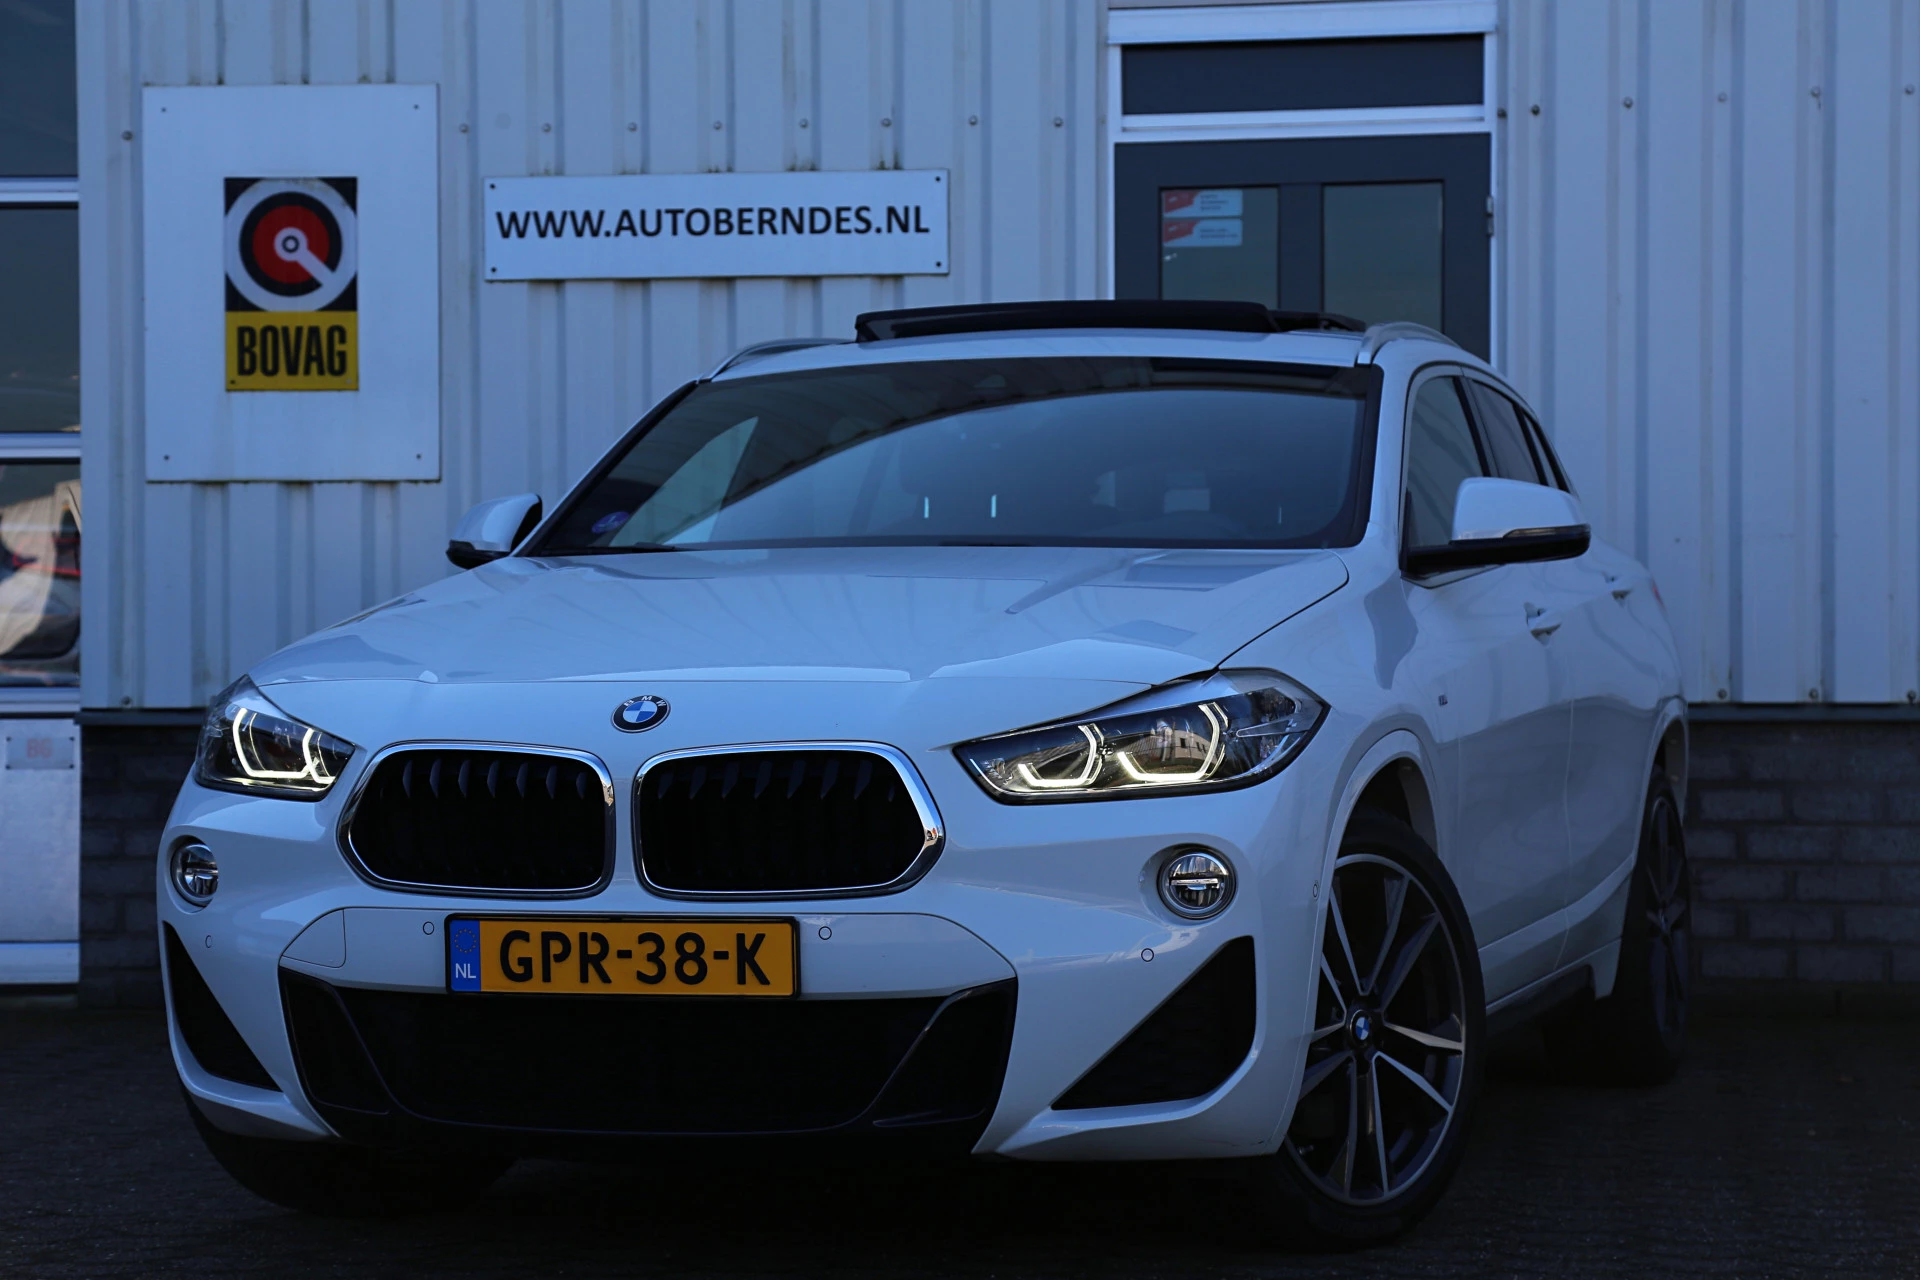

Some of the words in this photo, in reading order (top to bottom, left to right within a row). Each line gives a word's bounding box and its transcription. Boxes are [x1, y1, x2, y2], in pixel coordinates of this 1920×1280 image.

[496, 205, 929, 239] WWW.AUTOBERNDES.NL
[237, 325, 347, 377] BOVAG
[454, 963, 477, 980] NL
[500, 929, 771, 985] GPR-38-K
